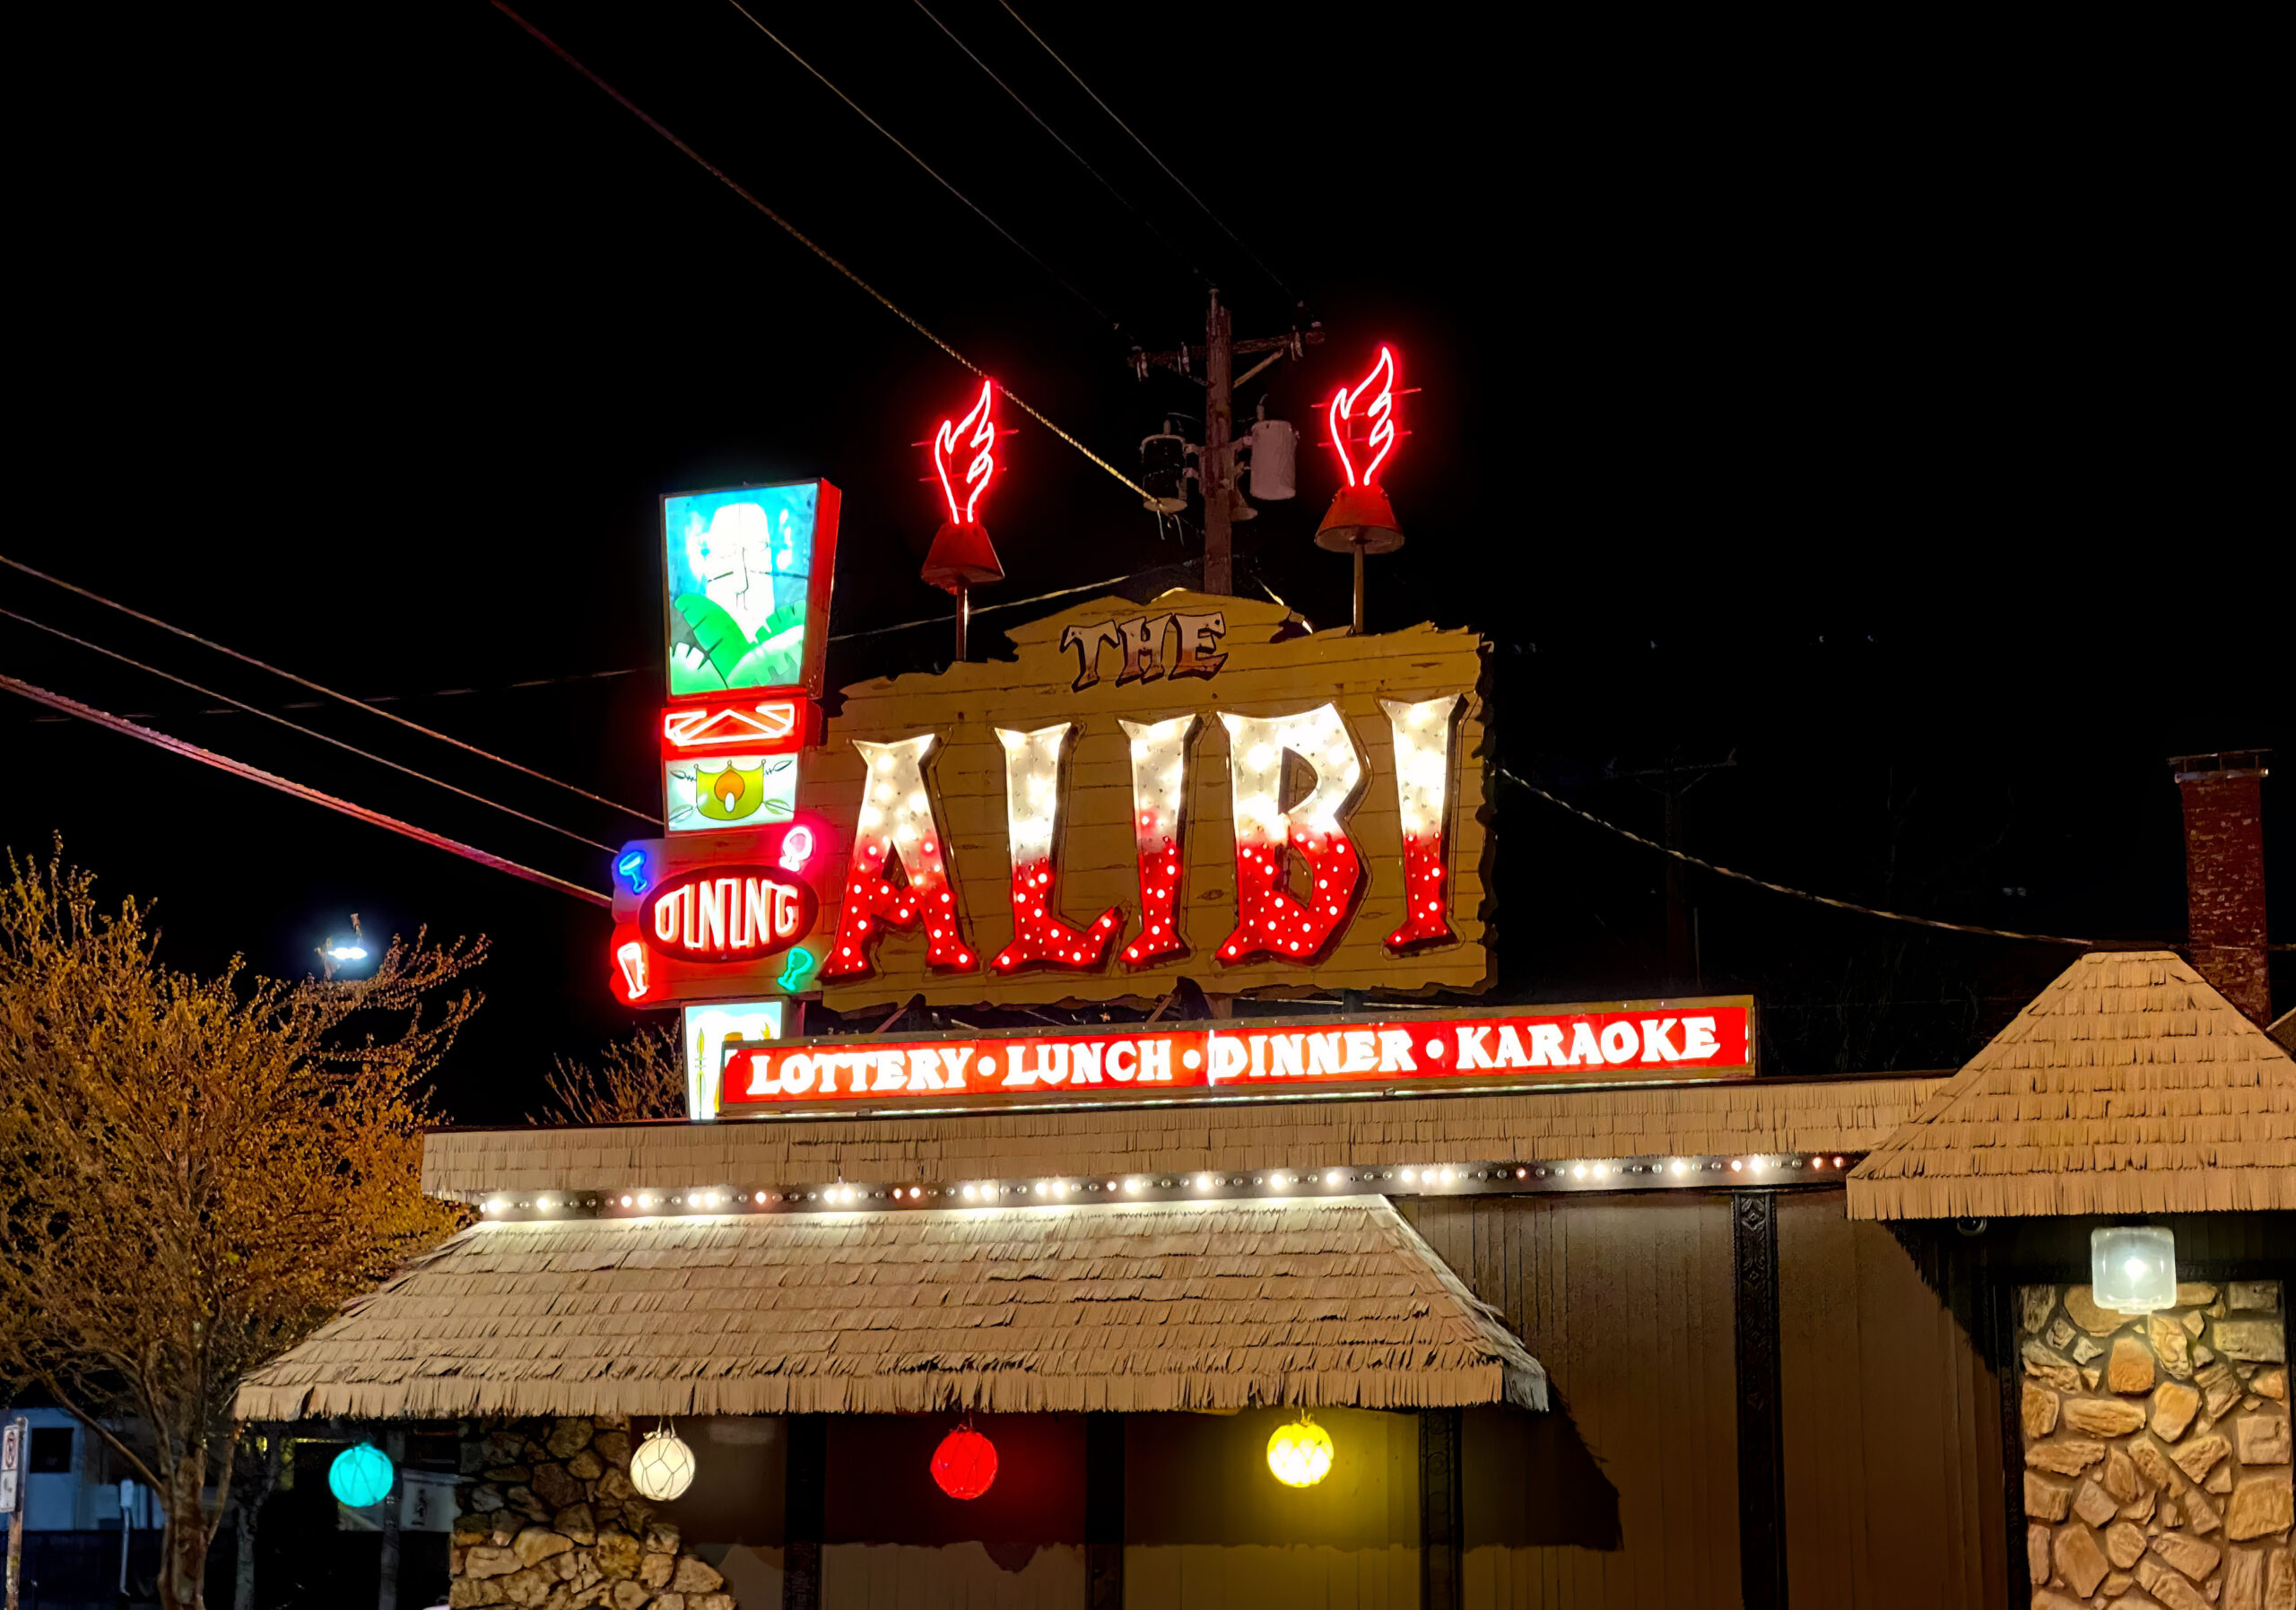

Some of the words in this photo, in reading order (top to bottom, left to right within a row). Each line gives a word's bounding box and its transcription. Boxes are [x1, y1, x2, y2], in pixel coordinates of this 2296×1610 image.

[1059, 612, 1229, 693] THE
[817, 693, 1468, 984] ALIBI
[655, 878, 798, 952] DINING
[746, 1048, 974, 1095] LOTTERY
[1001, 1040, 1172, 1086] LUNCH
[1210, 1030, 1418, 1077] DINNER
[1456, 1016, 1720, 1071] KARAOKE
